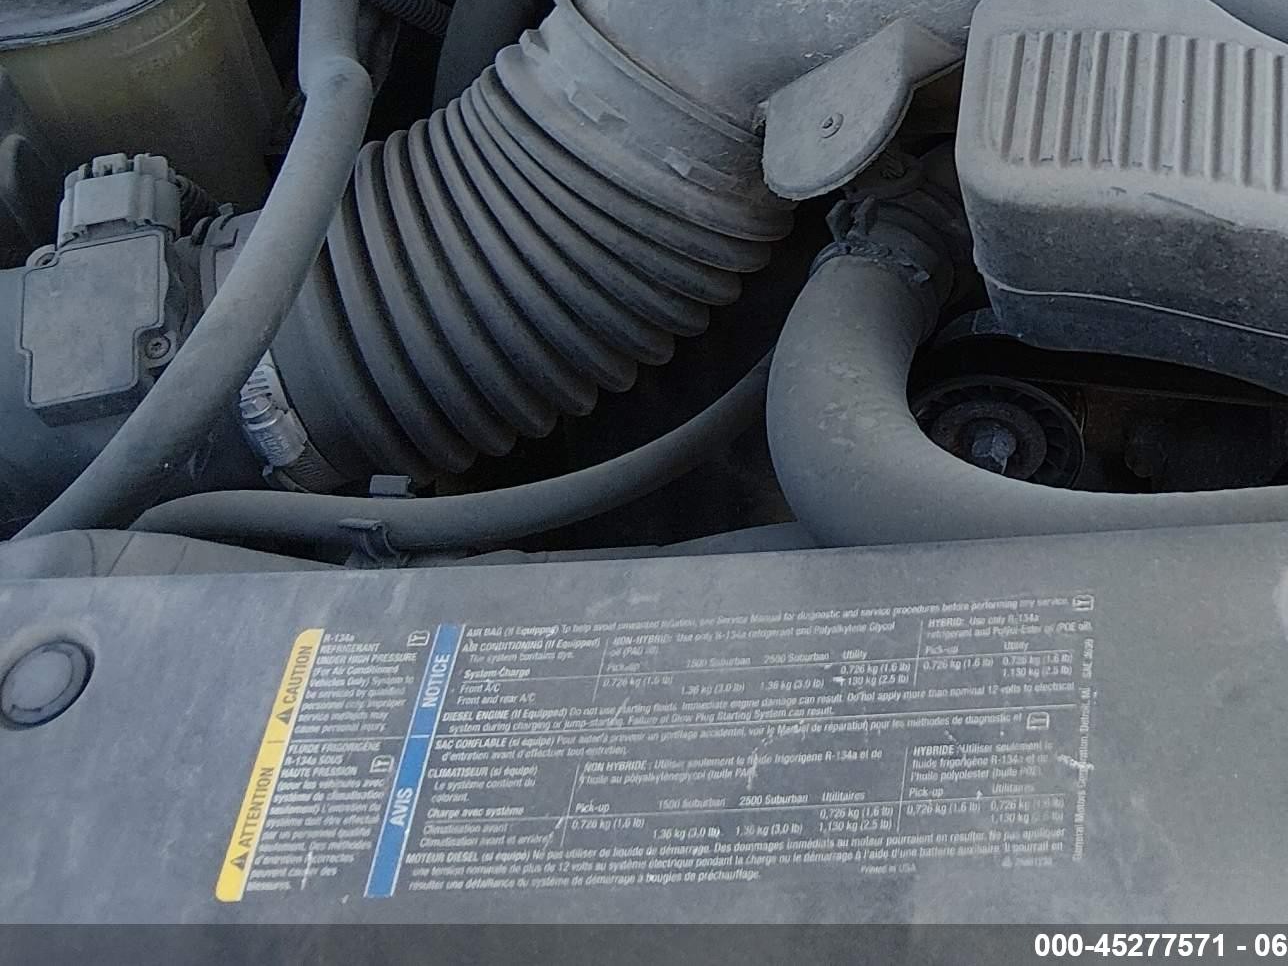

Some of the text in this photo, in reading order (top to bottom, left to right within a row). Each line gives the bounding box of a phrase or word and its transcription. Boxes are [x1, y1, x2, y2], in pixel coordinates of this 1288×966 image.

[283, 646, 313, 703] CAUTION
[421, 653, 450, 709] NOTICE
[800, 695, 815, 703] can
[877, 690, 901, 701] apply
[929, 687, 948, 697] than
[950, 685, 985, 696] nominal
[695, 712, 715, 723] Plug
[754, 708, 786, 719] System
[952, 715, 963, 724] de
[913, 745, 955, 756] HYBRIDE
[739, 794, 809, 805] 2500 Suburban
[238, 767, 274, 848] ATTENTION
[389, 787, 413, 827] AVIS
[935, 805, 946, 815] kg
[848, 808, 859, 819] kg
[847, 821, 858, 832] kg
[714, 842, 731, 852] Des
[685, 872, 696, 880] de
